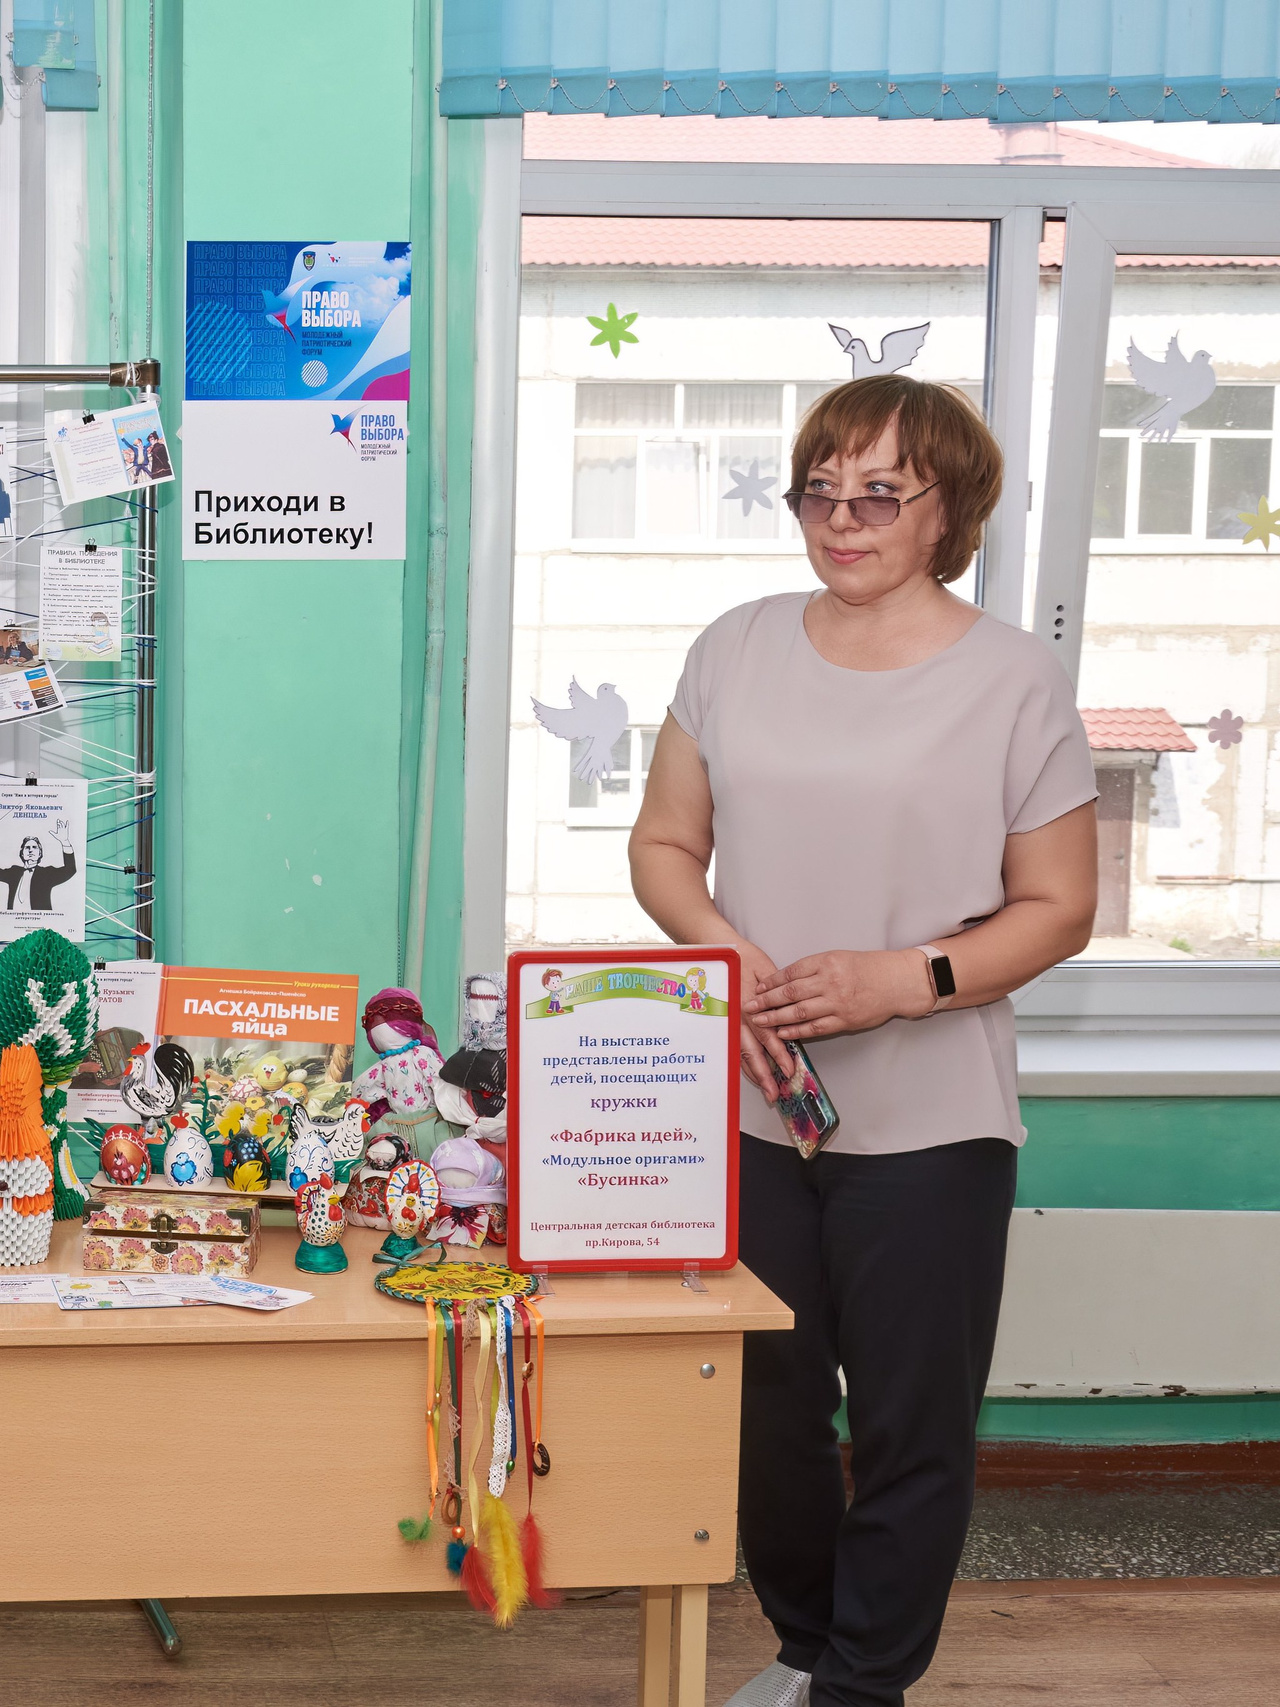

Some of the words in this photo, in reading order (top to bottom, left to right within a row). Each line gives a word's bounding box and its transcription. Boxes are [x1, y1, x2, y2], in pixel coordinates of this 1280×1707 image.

[194, 244, 234, 260] ПРАВО
[237, 244, 287, 260] ВЫБОРА
[194, 261, 234, 277] ПРАВО
[237, 261, 287, 277] ВЫБОРА
[194, 278, 234, 294] ПРАВО
[236, 295, 265, 310] ВЫБ
[302, 291, 349, 309] ПРАВО
[302, 310, 361, 327] ВЫБОРА
[302, 339, 352, 347] ПАТРИОТИЧЕСКИЙ
[193, 381, 232, 396] ПРАВО
[236, 381, 286, 396] ВЫБОРА
[361, 415, 395, 427] ПРАВО
[361, 428, 404, 440] ВЫБОРА
[194, 490, 319, 518] Приходи
[329, 495, 346, 512] в
[194, 521, 373, 549] Библиотеку!
[293, 980, 311, 989] Уроки
[608, 973, 686, 998] ТВОРЧЕСТВО
[183, 999, 340, 1022] ПАСХАЛЬНЫЕ
[231, 1017, 288, 1038] яйца
[579, 1035, 597, 1047] На
[602, 1035, 670, 1048] выставке
[542, 1054, 648, 1068] представлены
[651, 1052, 706, 1067] работы
[550, 1072, 597, 1086] детей,
[600, 1072, 697, 1085] посещающих
[590, 1096, 658, 1112] кружки
[550, 1128, 637, 1146] «Фабрика
[640, 1128, 697, 1144] идей»,
[542, 1154, 632, 1168] «Модульное
[635, 1154, 705, 1167] оригами»
[578, 1173, 669, 1189] «Бусинка»
[530, 1221, 602, 1233] Центральная
[605, 1220, 648, 1231] детская
[650, 1219, 715, 1230] библиотека
[585, 1237, 644, 1249] пр.Кирова,
[646, 1236, 660, 1247] 54
